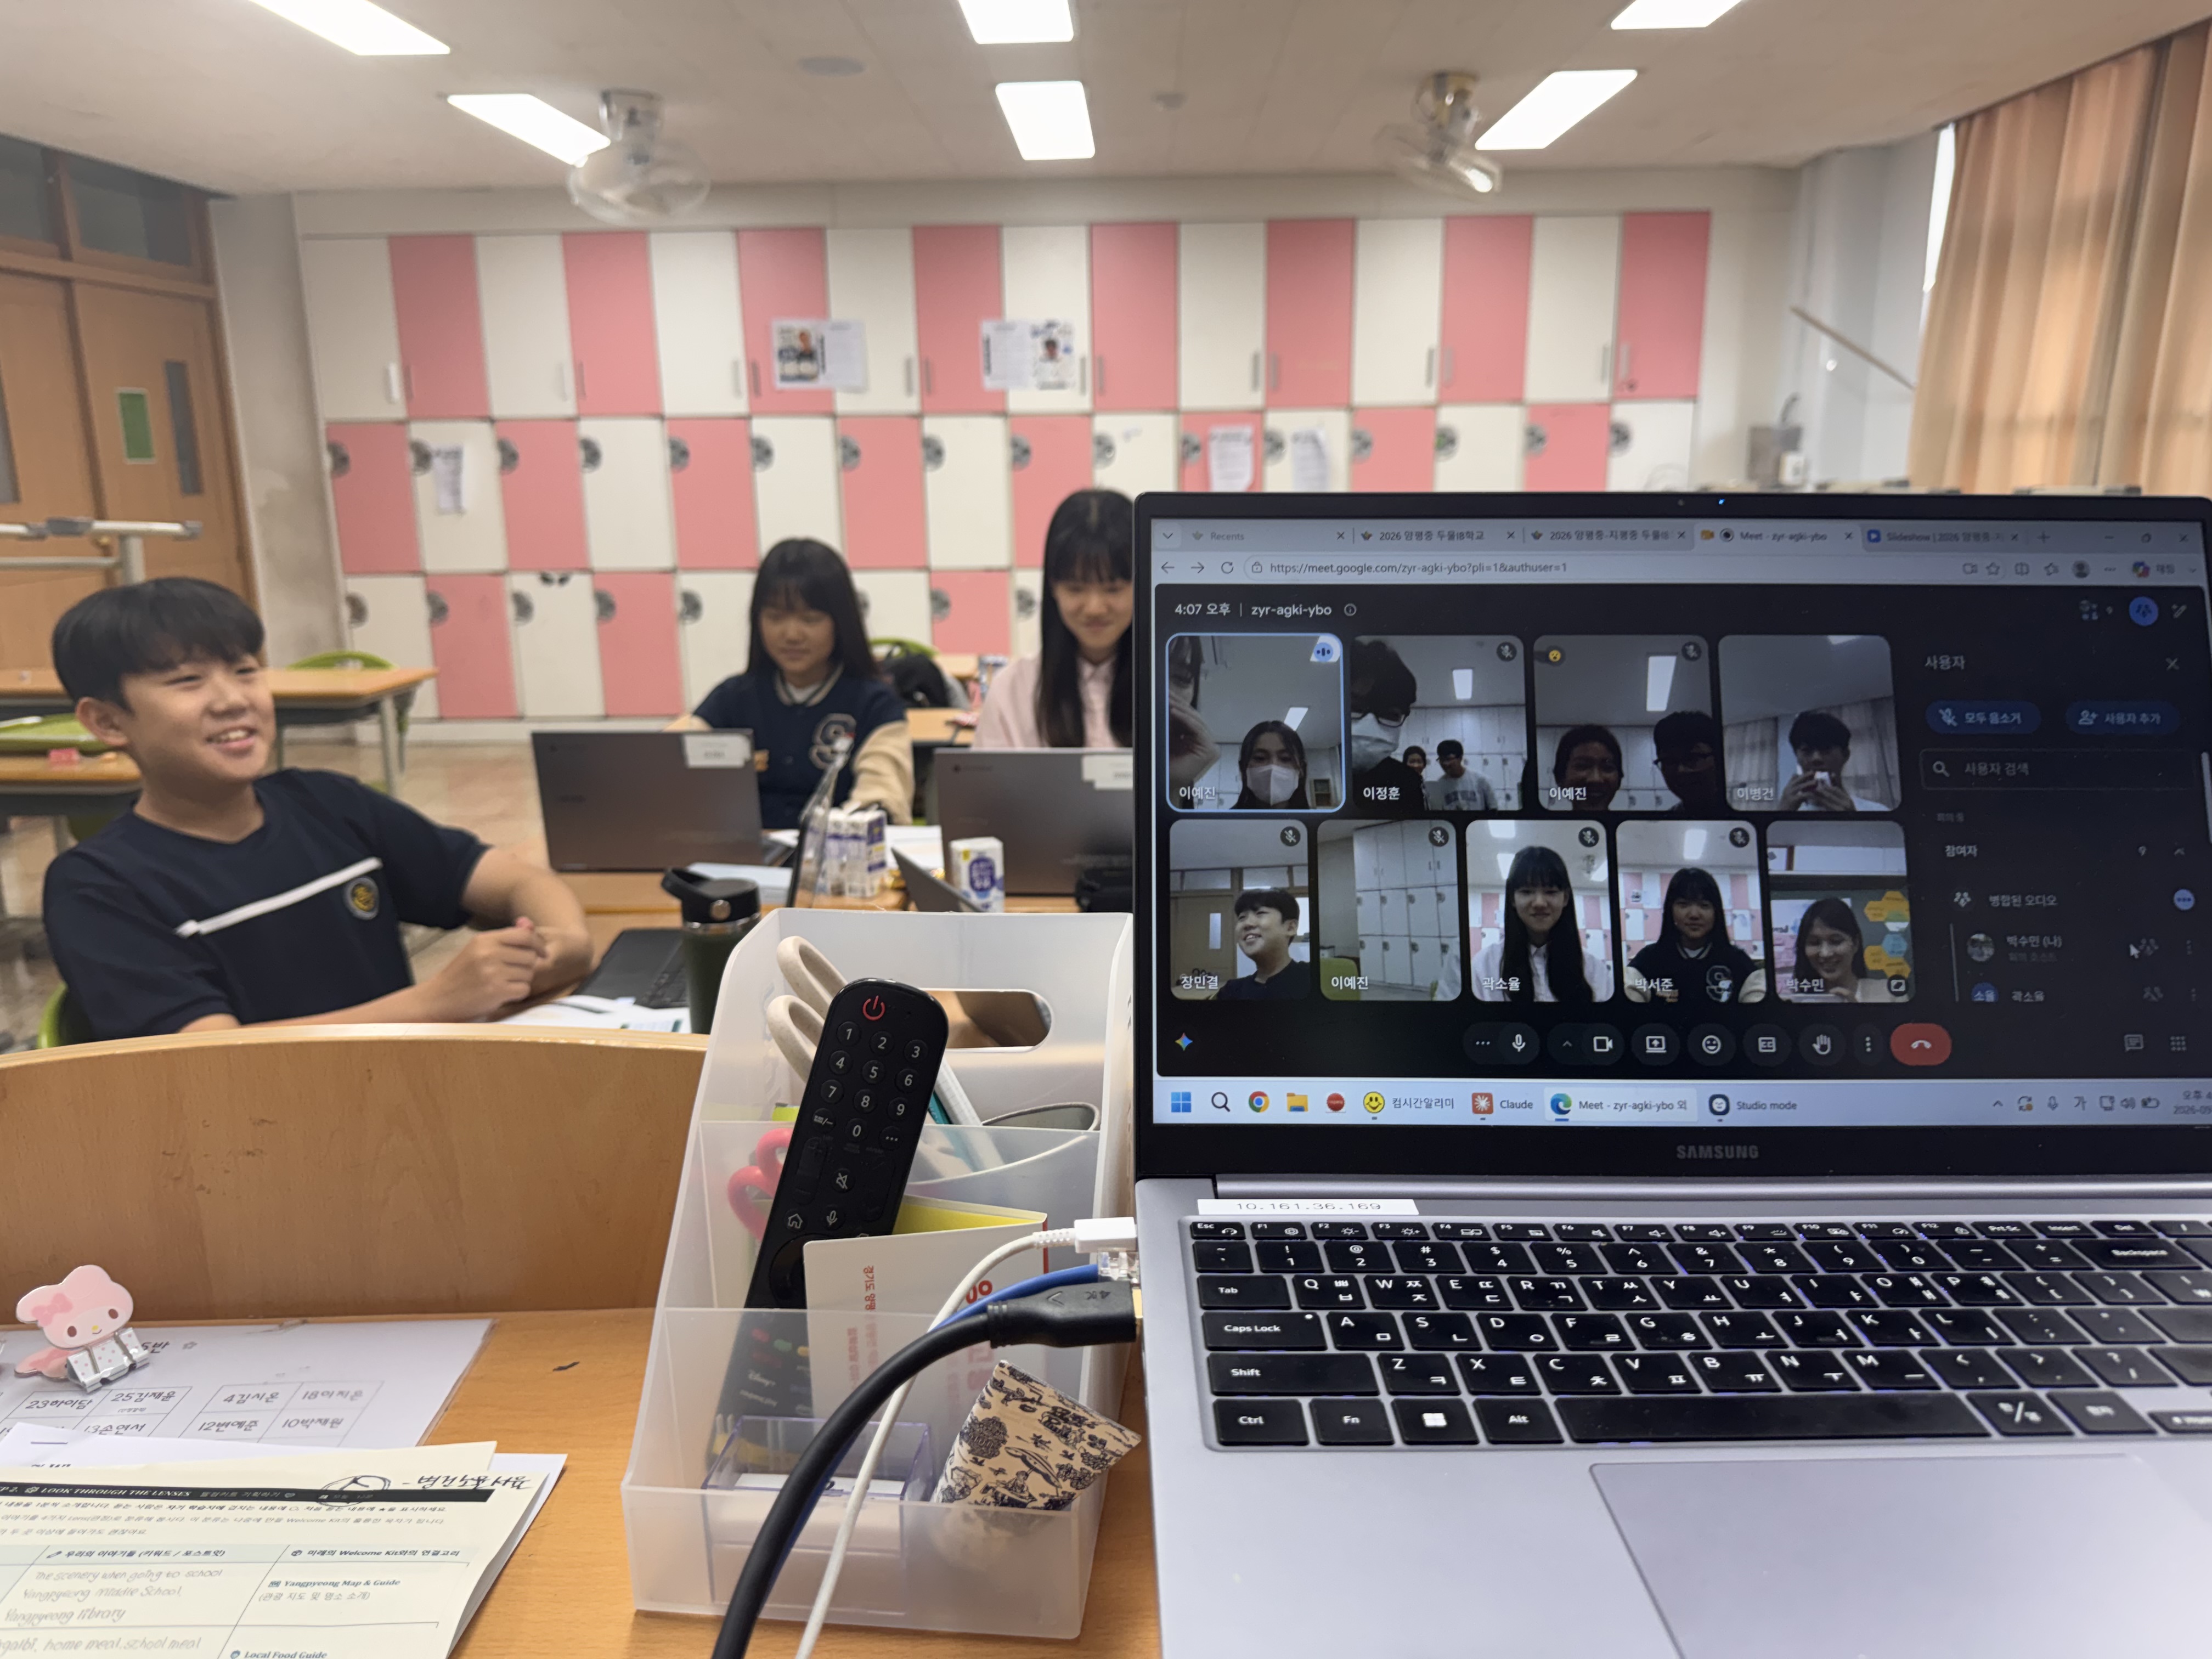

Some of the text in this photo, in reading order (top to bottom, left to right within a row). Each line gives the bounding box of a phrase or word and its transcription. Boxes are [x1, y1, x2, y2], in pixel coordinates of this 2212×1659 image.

[1211, 532, 1244, 541] Recents
[1379, 532, 1401, 540] 2026
[1270, 562, 1567, 575] https://meet.google.com/zyr-agki-ybo?pli=1&authuser=1
[1175, 603, 1231, 617] 4:07 오후
[1251, 604, 1333, 618] zyr-agki-ybo
[1925, 654, 1965, 670] 사용자
[1179, 786, 1216, 800] 이예진
[1363, 786, 1400, 800] 이정훈
[1549, 787, 1587, 801] 이예진
[1945, 844, 1978, 858] 참여자
[2024, 894, 2057, 907] 오디오
[1181, 975, 1218, 990] 장민결
[1331, 975, 1369, 990] 이예진
[1634, 977, 1673, 993] 박서준
[1786, 978, 1824, 992] 박수민
[847, 1029, 852, 1040] 1
[878, 1037, 887, 1049] 2
[912, 1046, 920, 1058] 3
[836, 1057, 844, 1068] 4
[870, 1066, 878, 1078] 5
[905, 1075, 913, 1086] 6
[829, 1086, 837, 1097] 7
[861, 1096, 870, 1107] 8
[1392, 1097, 1455, 1111] 컴시간알리미
[1500, 1099, 1534, 1110] Claude
[1579, 1101, 1674, 1113] Meet zyr-agki-ybo
[1737, 1101, 1798, 1111] Studio mode
[896, 1104, 905, 1115] 9
[853, 1125, 861, 1136] 0
[1676, 1145, 1759, 1160] SAMSUNG
[1237, 1202, 1381, 1211] 10.161.36.169
[863, 1265, 876, 1291] 경기도
[1376, 1279, 1392, 1288] W
[1305, 1279, 1318, 1289] Q
[1449, 1280, 1462, 1289] E
[1521, 1280, 1534, 1289] R
[1593, 1281, 1602, 1289] T
[1663, 1280, 1674, 1289] Y
[1734, 1280, 1750, 1288] U
[1341, 1317, 1354, 1326] A
[1416, 1317, 1429, 1327] S
[1490, 1318, 1504, 1327] D
[1566, 1318, 1576, 1327] F
[1640, 1318, 1655, 1327] G
[1713, 1316, 1730, 1325] H
[1392, 1358, 1406, 1369] Z
[1471, 1359, 1485, 1369] X
[1549, 1359, 1564, 1369] C
[1626, 1359, 1639, 1369] V
[1704, 1357, 1720, 1367] B
[1781, 1356, 1799, 1366] N
[1857, 1355, 1878, 1365] M
[111, 1391, 177, 1403] 25김재윤
[65, 1550, 95, 1558] 우리의
[101, 1570, 127, 1579] when
[127, 1569, 162, 1582] going
[184, 1568, 223, 1578] school
[284, 1580, 341, 1588] Yangpyeong
[287, 1592, 307, 1601] 지도
[244, 1650, 328, 1659] Local Food Guide
